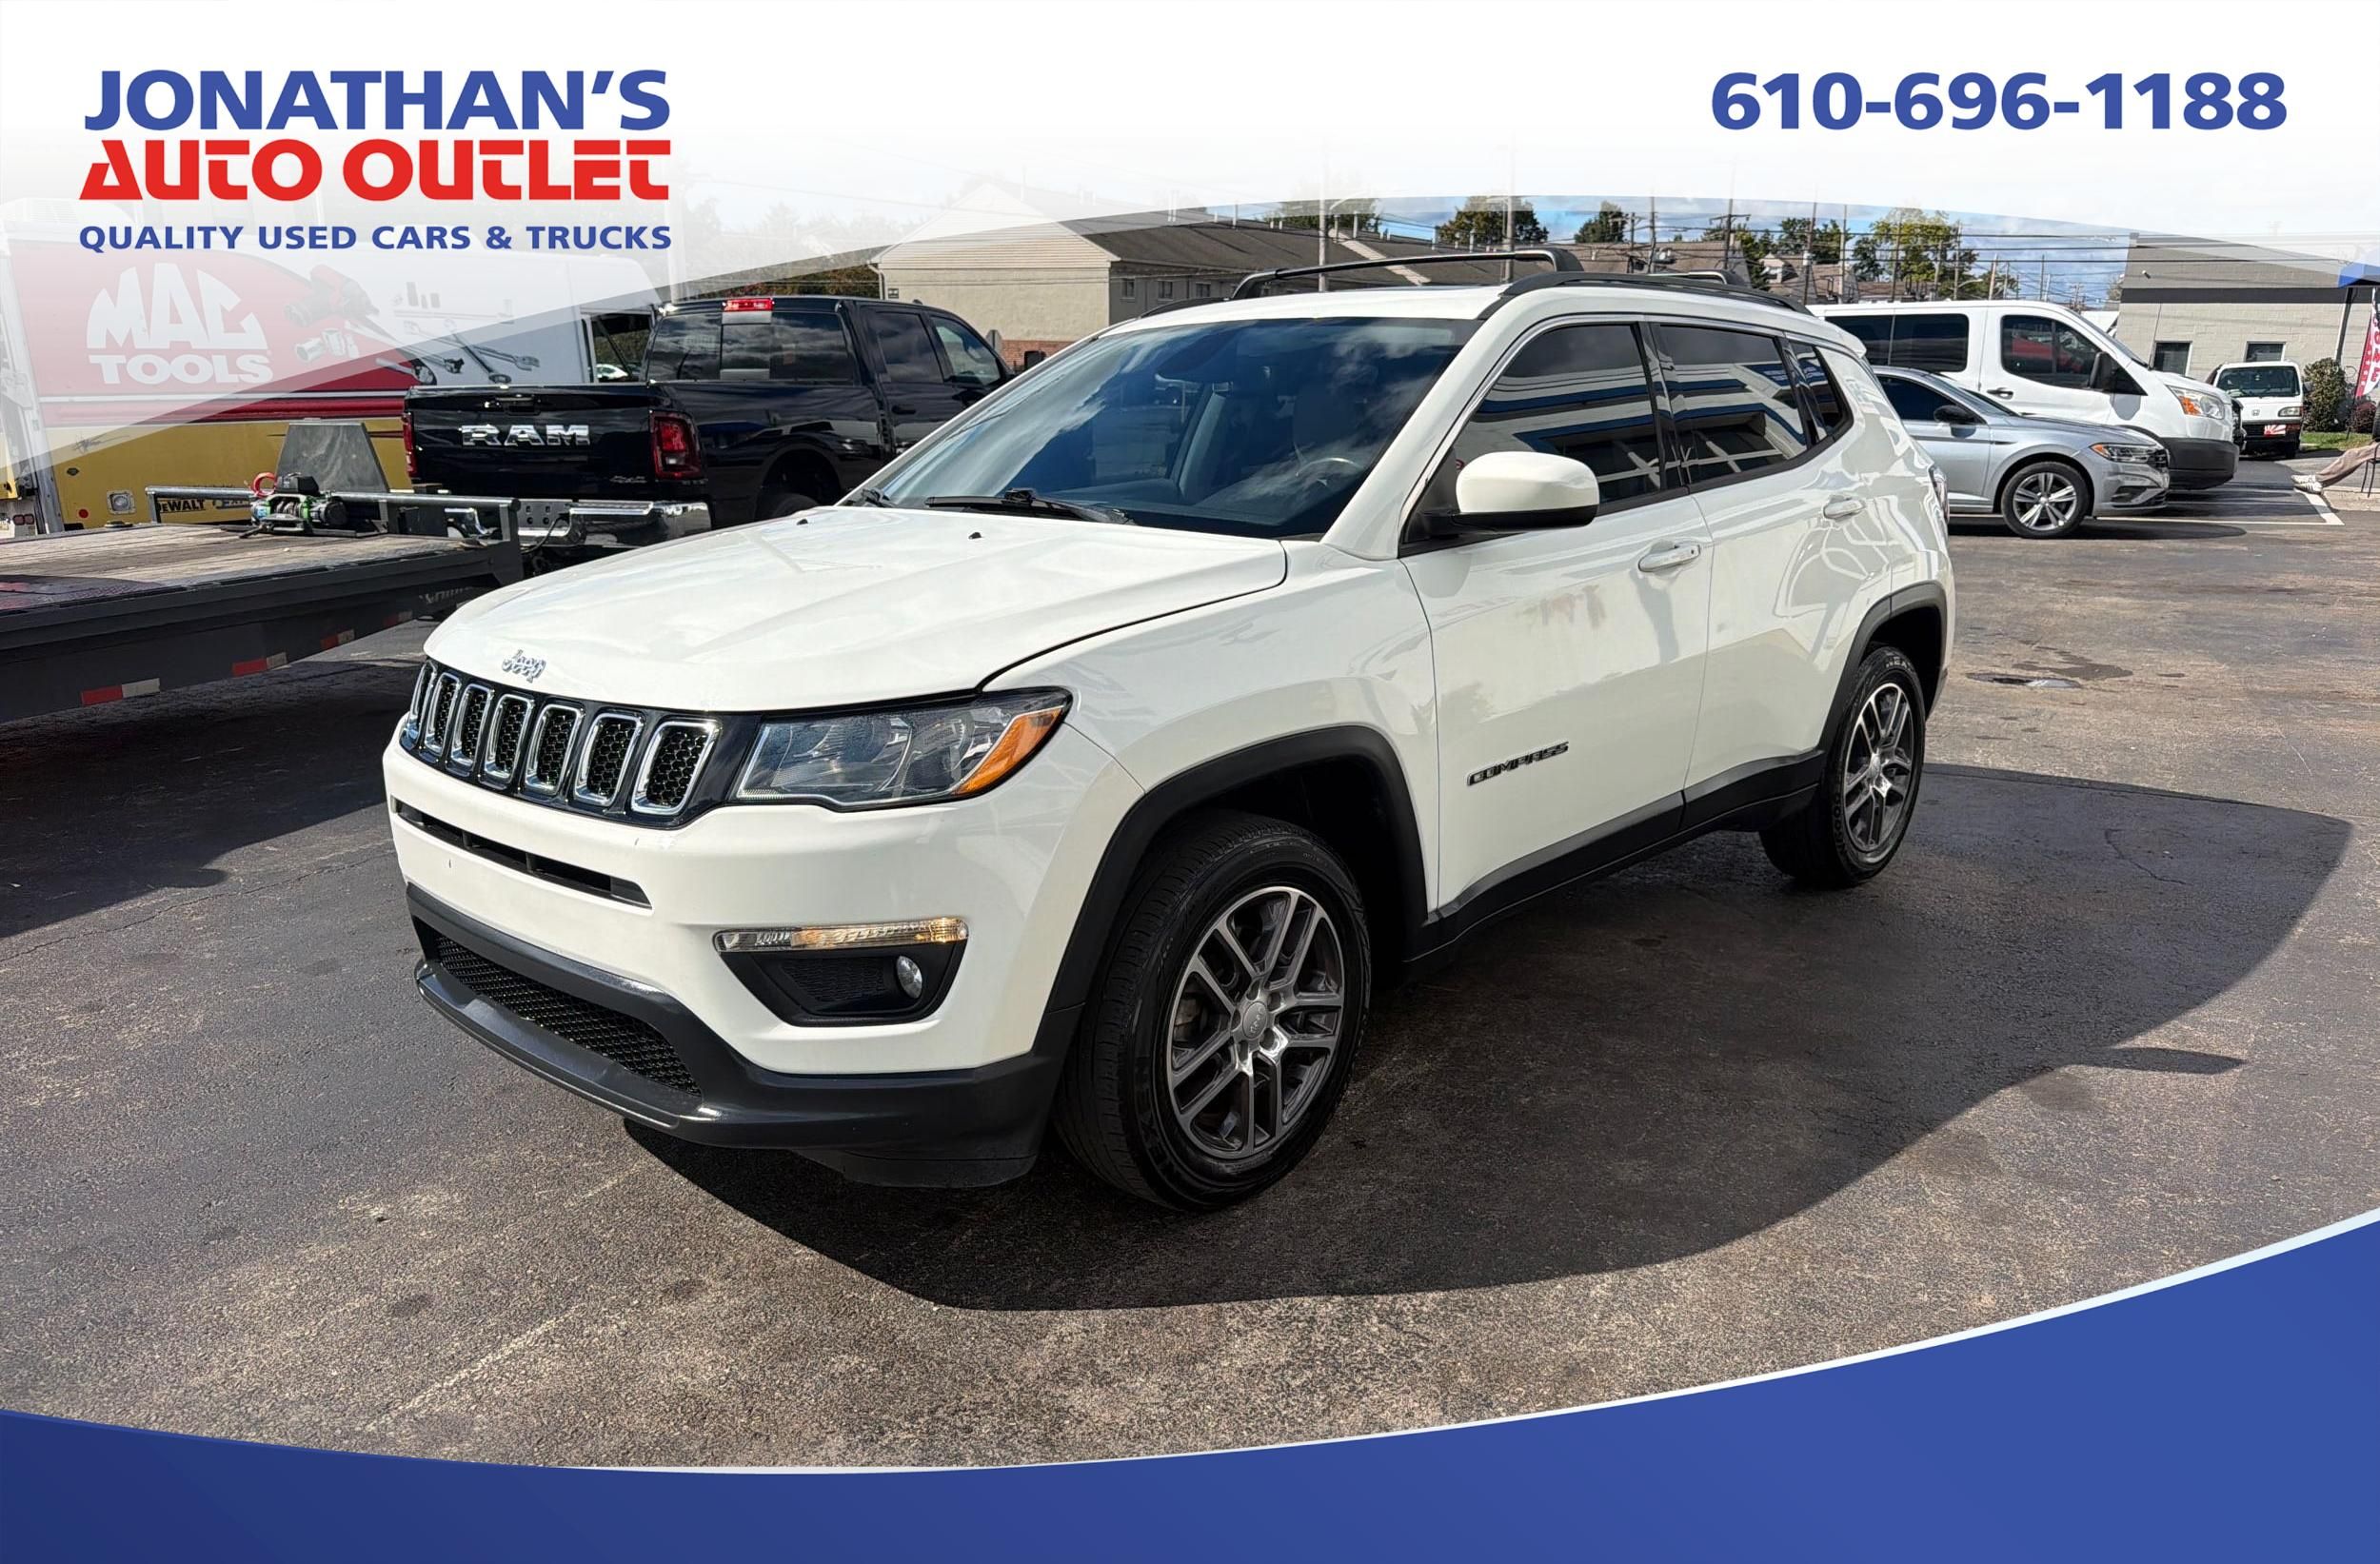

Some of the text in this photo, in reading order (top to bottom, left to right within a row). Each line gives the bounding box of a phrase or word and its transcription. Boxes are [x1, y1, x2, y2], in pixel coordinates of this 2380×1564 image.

[86, 262, 268, 350] MAC
[88, 353, 273, 385] TOOLS
[460, 424, 591, 446] RAM
[502, 649, 546, 683] Jeep
[1467, 741, 1569, 786] COMPASS
